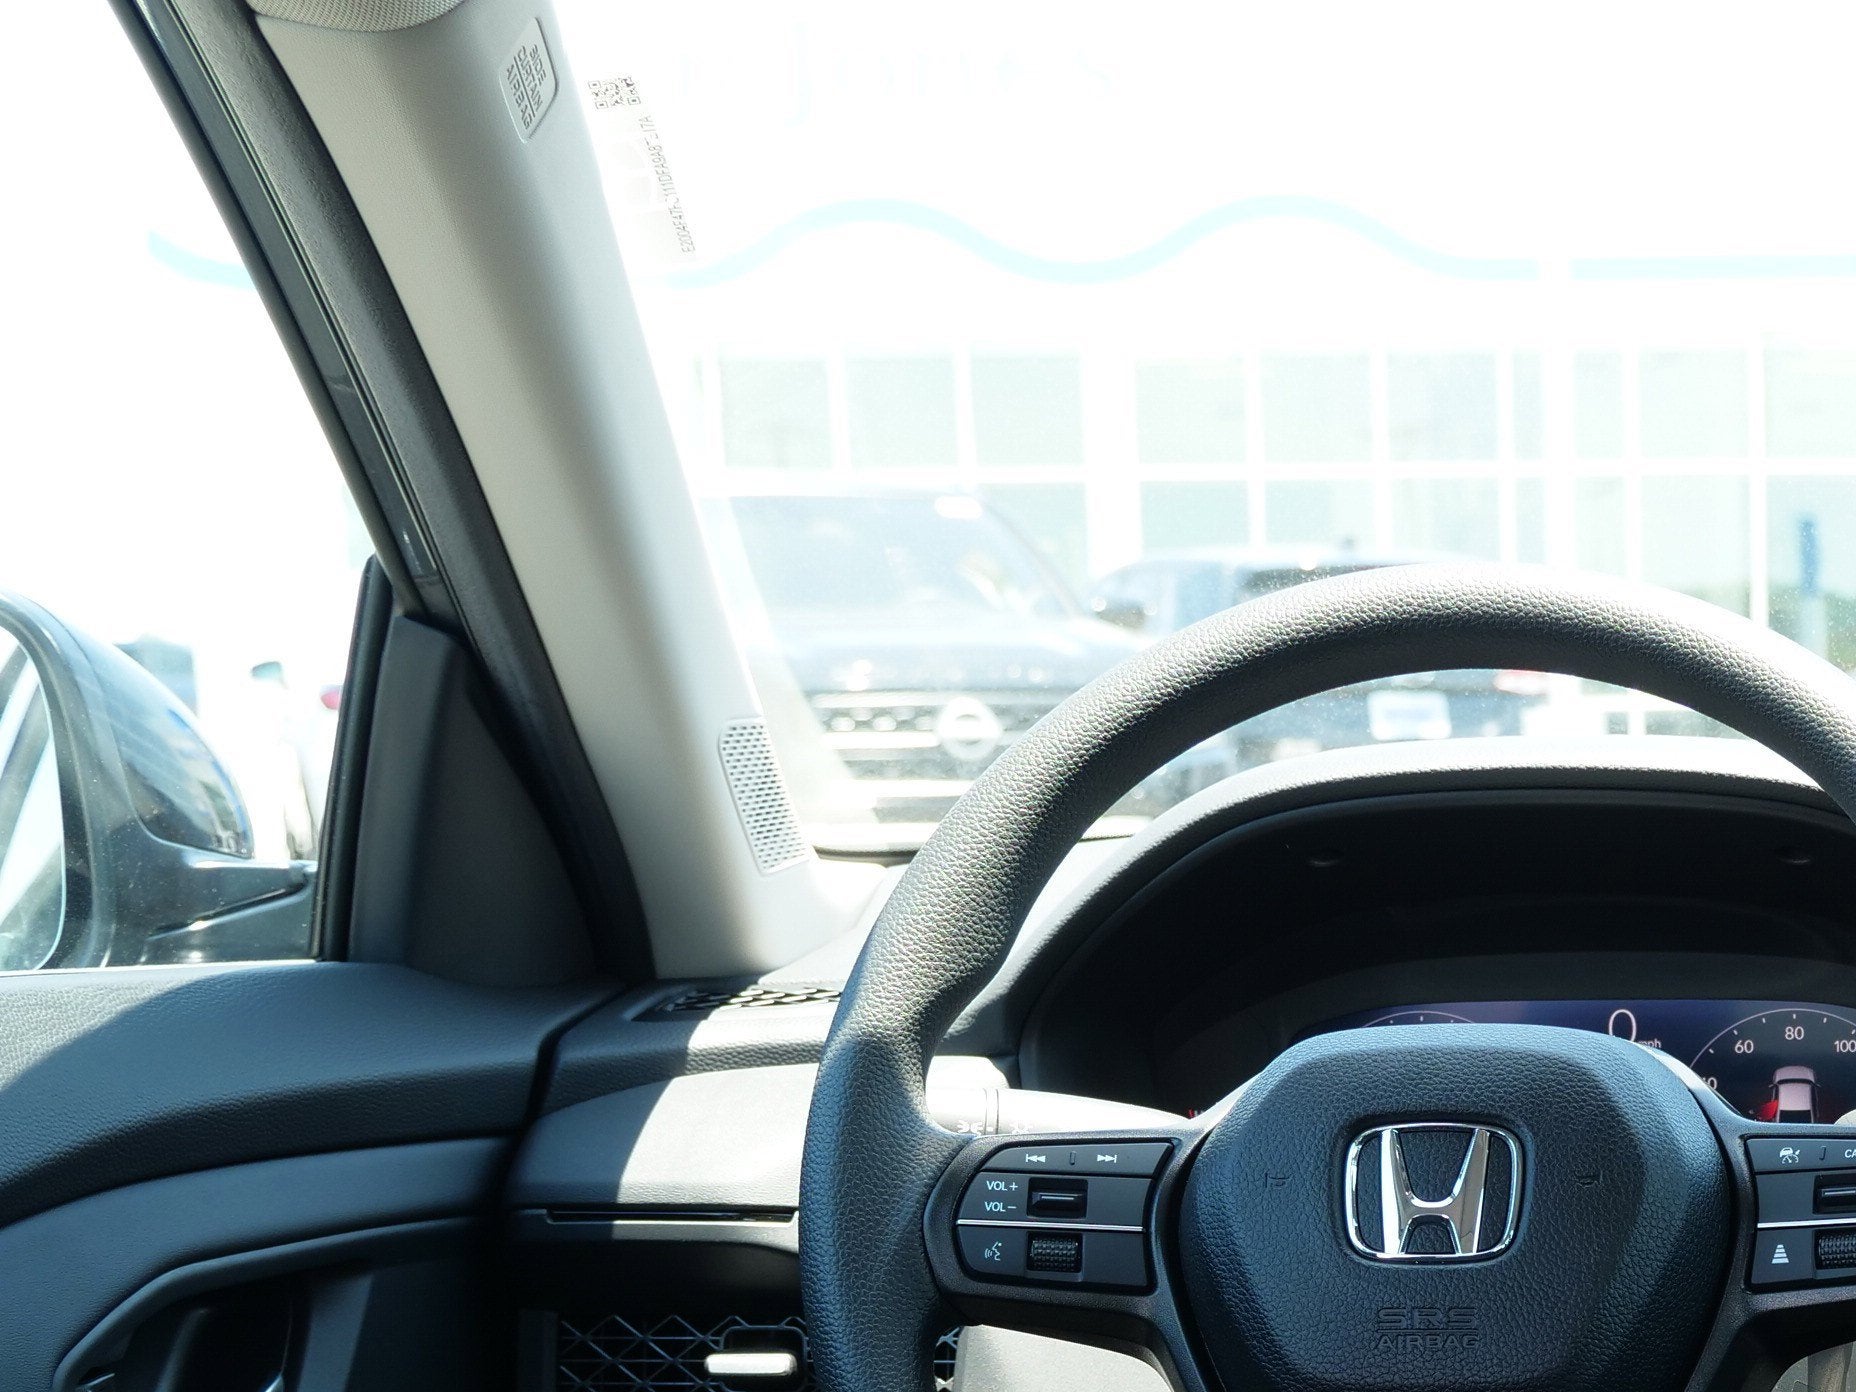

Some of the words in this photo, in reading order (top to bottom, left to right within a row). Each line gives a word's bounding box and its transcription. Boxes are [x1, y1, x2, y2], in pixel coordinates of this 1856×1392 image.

[530, 44, 547, 85] SIDE
[517, 45, 541, 113] CURTAIN
[506, 64, 533, 129] AIRBAG
[1785, 1026, 1804, 1040] 80
[1735, 1040, 1754, 1054] 60
[1375, 1307, 1477, 1328] SRS
[1374, 1334, 1479, 1351] AIRBAG
